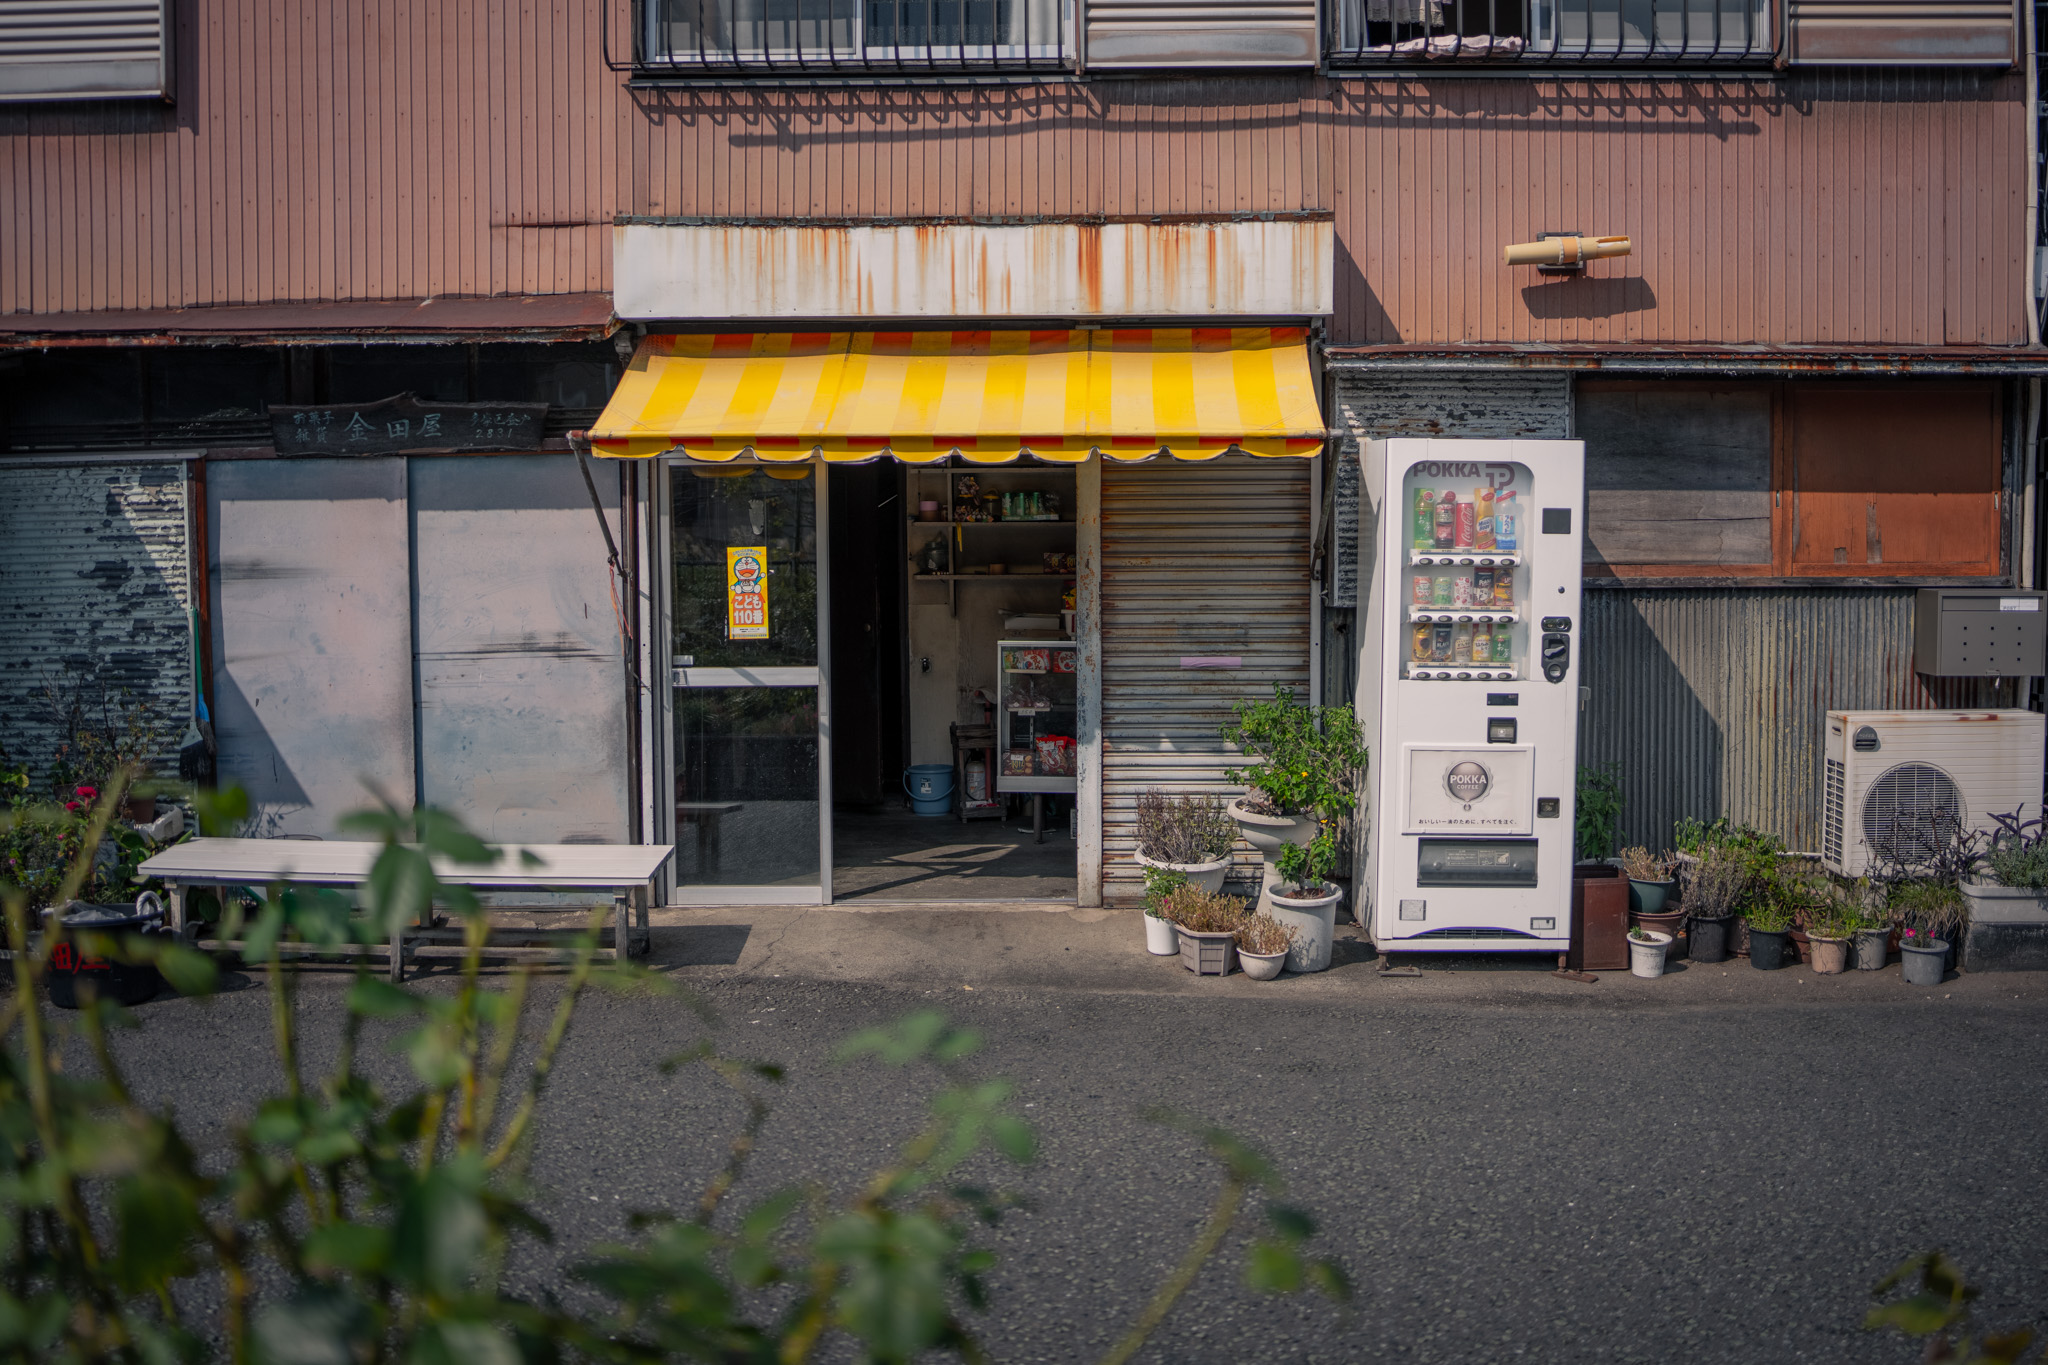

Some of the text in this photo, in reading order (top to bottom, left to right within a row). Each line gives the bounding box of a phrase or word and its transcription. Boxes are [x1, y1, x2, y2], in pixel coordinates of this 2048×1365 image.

[293, 411, 335, 425] お菓子
[343, 411, 443, 442] 金田屋
[475, 427, 513, 439] 2831
[1413, 462, 1481, 478] POKKA
[734, 595, 762, 609] こども
[734, 610, 763, 624] 110番
[1450, 774, 1487, 784] POKKA
